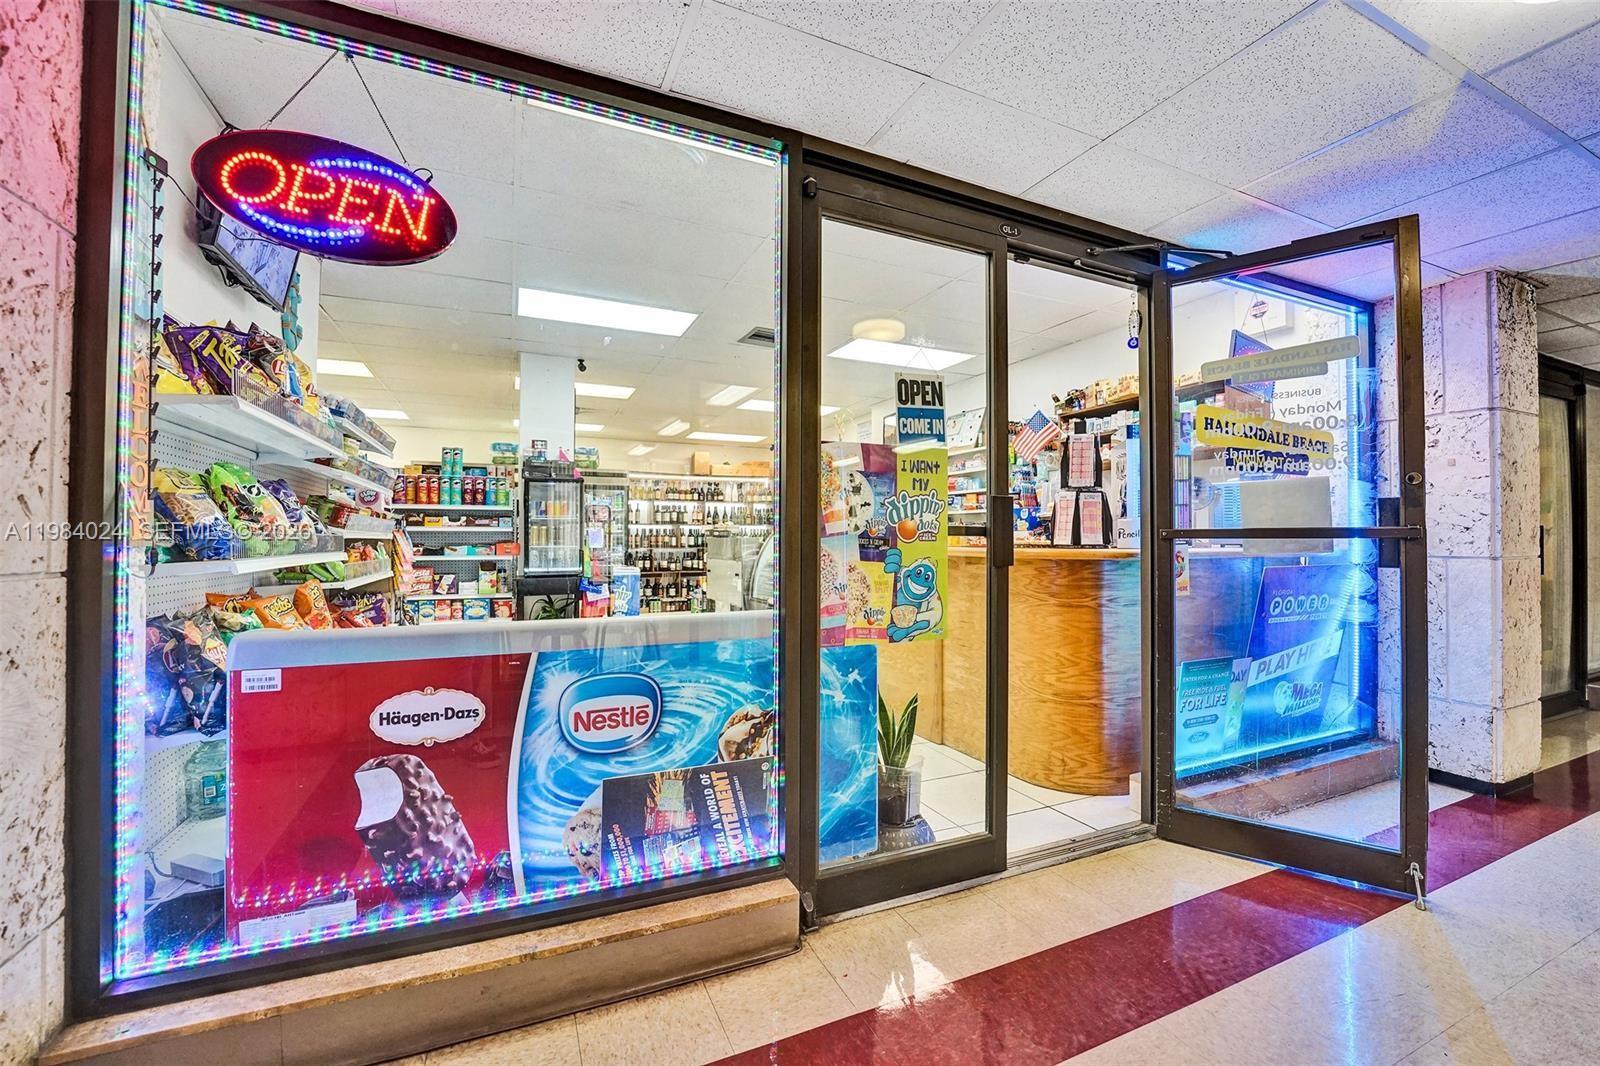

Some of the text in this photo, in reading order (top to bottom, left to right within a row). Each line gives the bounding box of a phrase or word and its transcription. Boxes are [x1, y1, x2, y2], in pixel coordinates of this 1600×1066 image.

[221, 152, 435, 241] OPEN
[897, 378, 943, 406] OPEN
[899, 417, 944, 435] COME IN
[901, 461, 907, 472] I
[911, 478, 930, 491] MY
[917, 517, 939, 533] dots
[1271, 594, 1329, 615] POWER
[1255, 650, 1296, 680] PLAY
[1180, 693, 1227, 713] FOR LIFE
[379, 706, 480, 728] Häagen-Dazs
[573, 704, 650, 733] Nestlé
[700, 773, 711, 785] OF
[704, 788, 720, 821] WORLD
[710, 770, 748, 861] XCITEMENT
